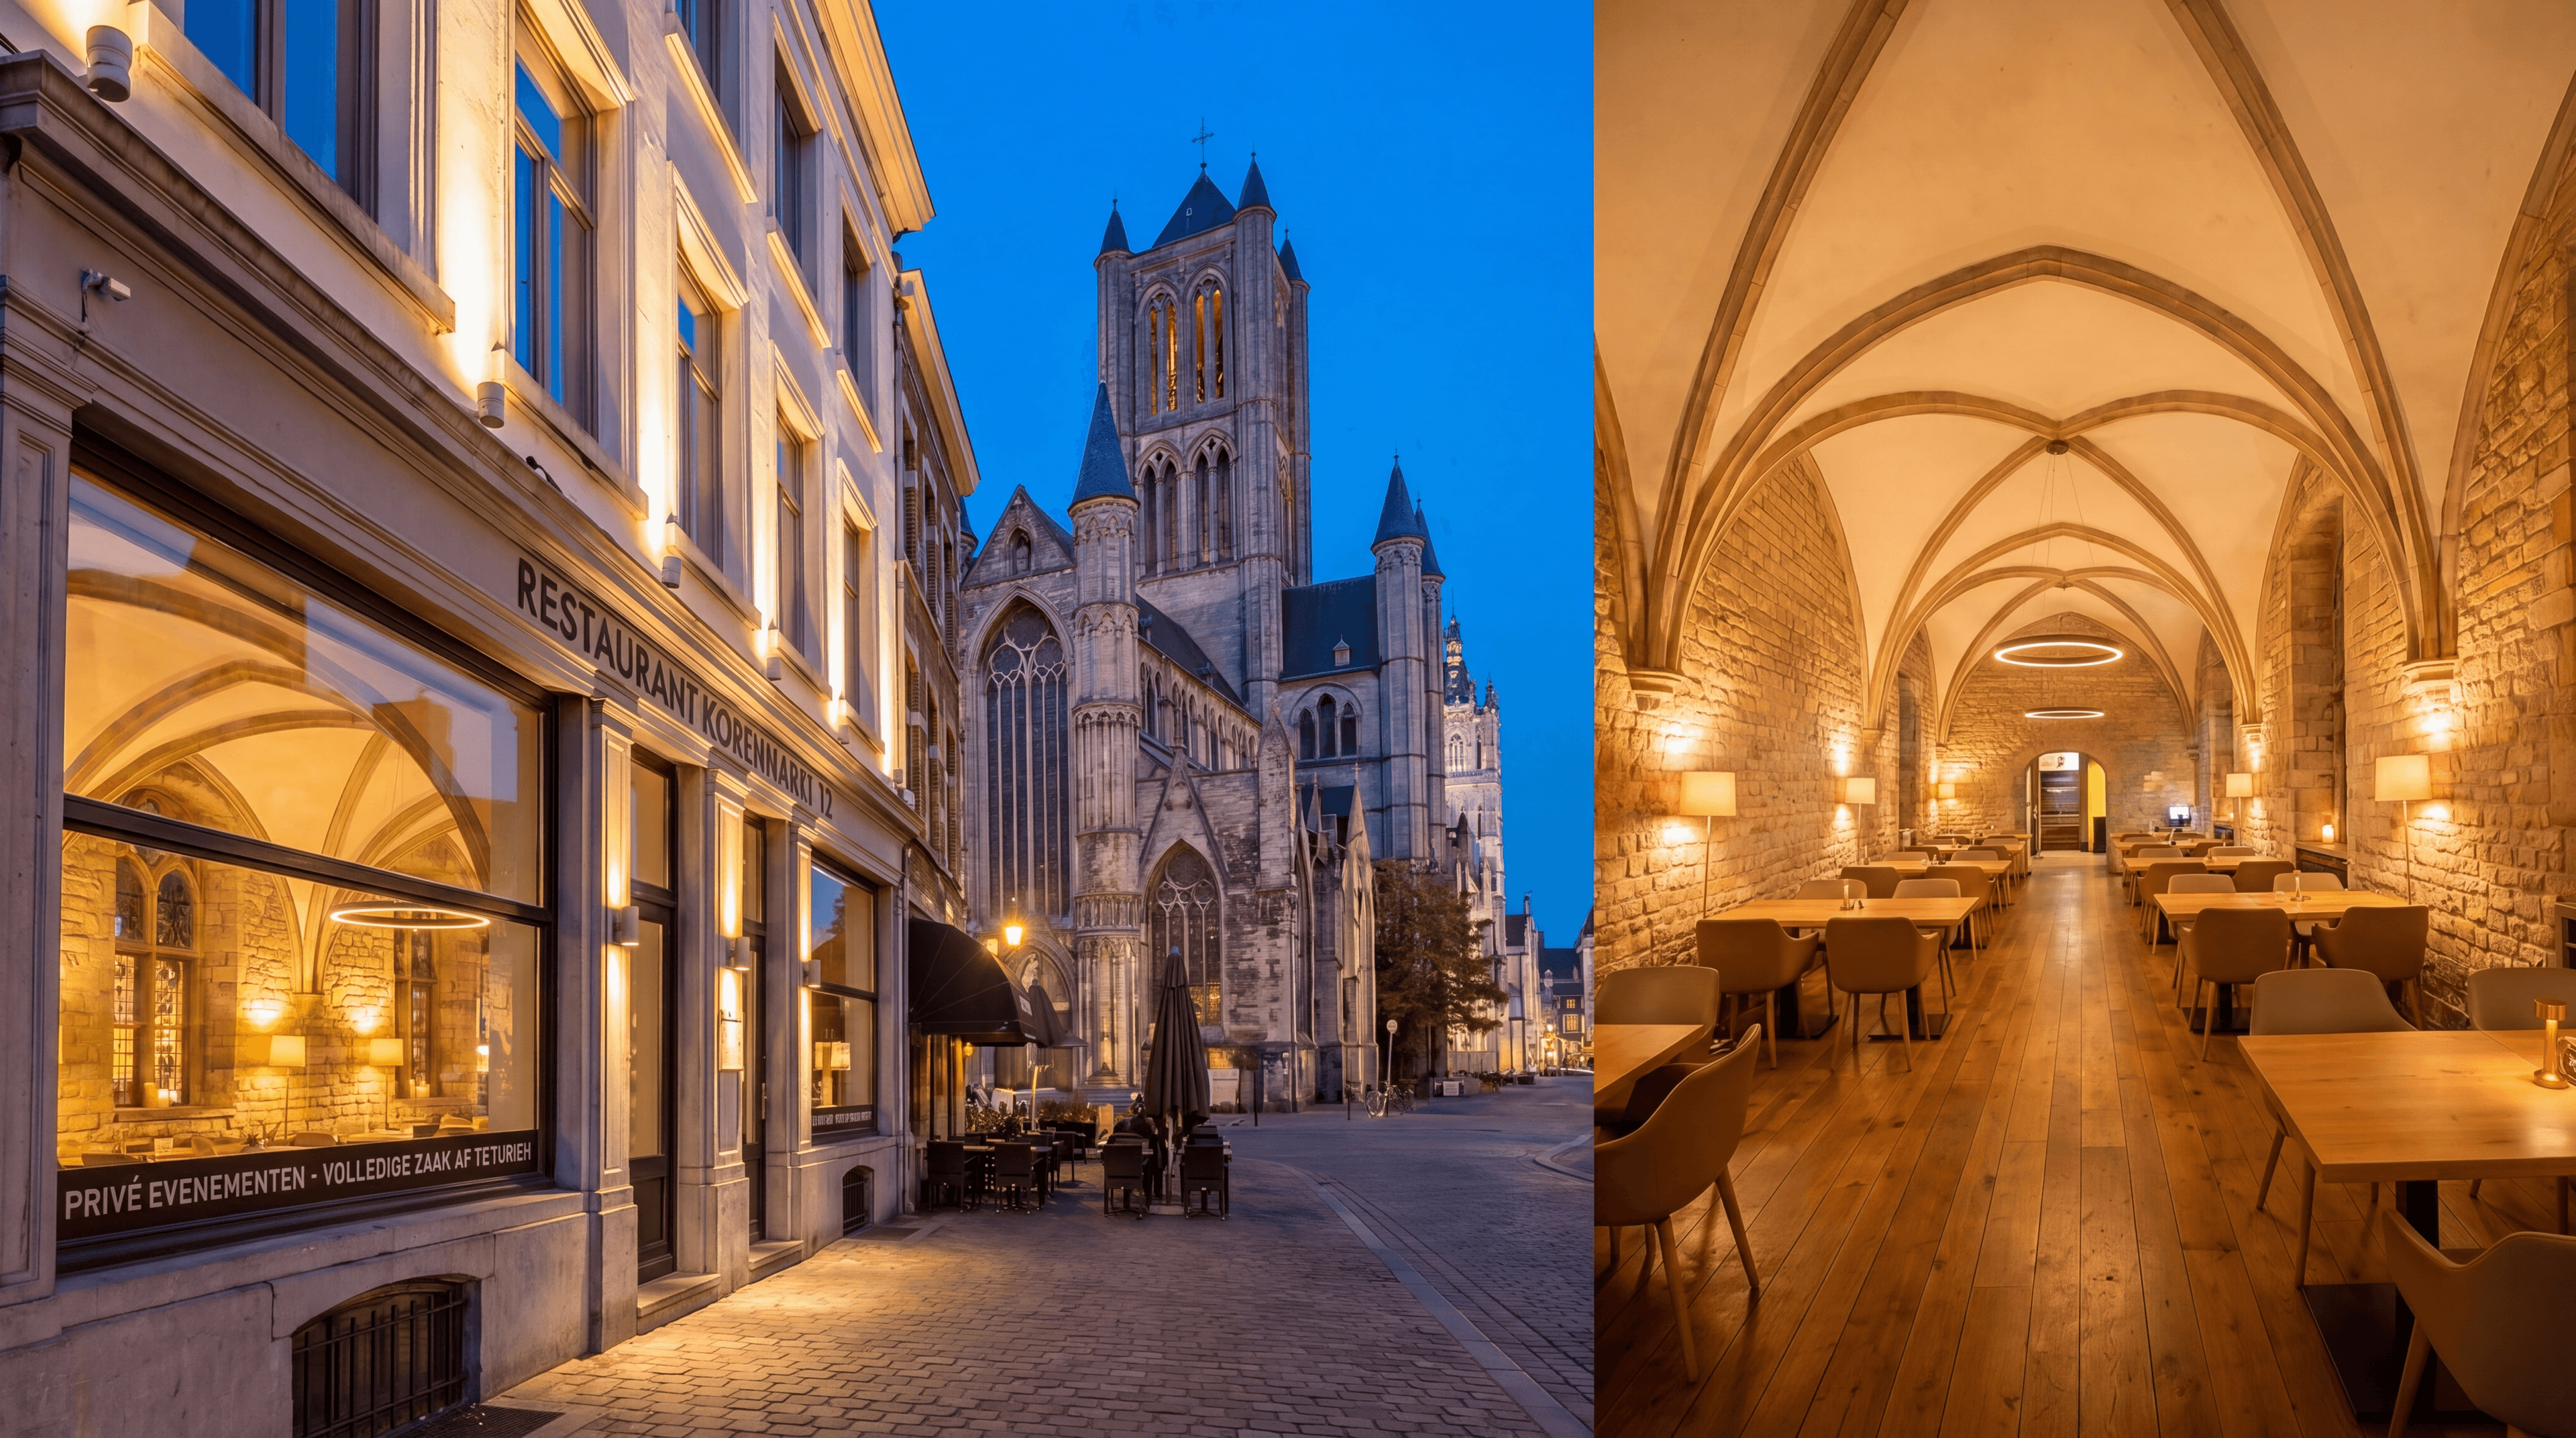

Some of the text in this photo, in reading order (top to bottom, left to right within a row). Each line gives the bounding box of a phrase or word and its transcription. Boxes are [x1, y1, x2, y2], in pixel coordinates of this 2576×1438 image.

[518, 557, 698, 725] RESTAURANT
[818, 781, 833, 820] 12
[65, 1174, 142, 1220] PRIVÉ
[149, 1166, 305, 1209] EVENEMENTEN
[323, 1154, 411, 1186] VOLLEDIGE
[415, 1150, 451, 1174] ZAAK
[454, 1148, 472, 1169] AF
